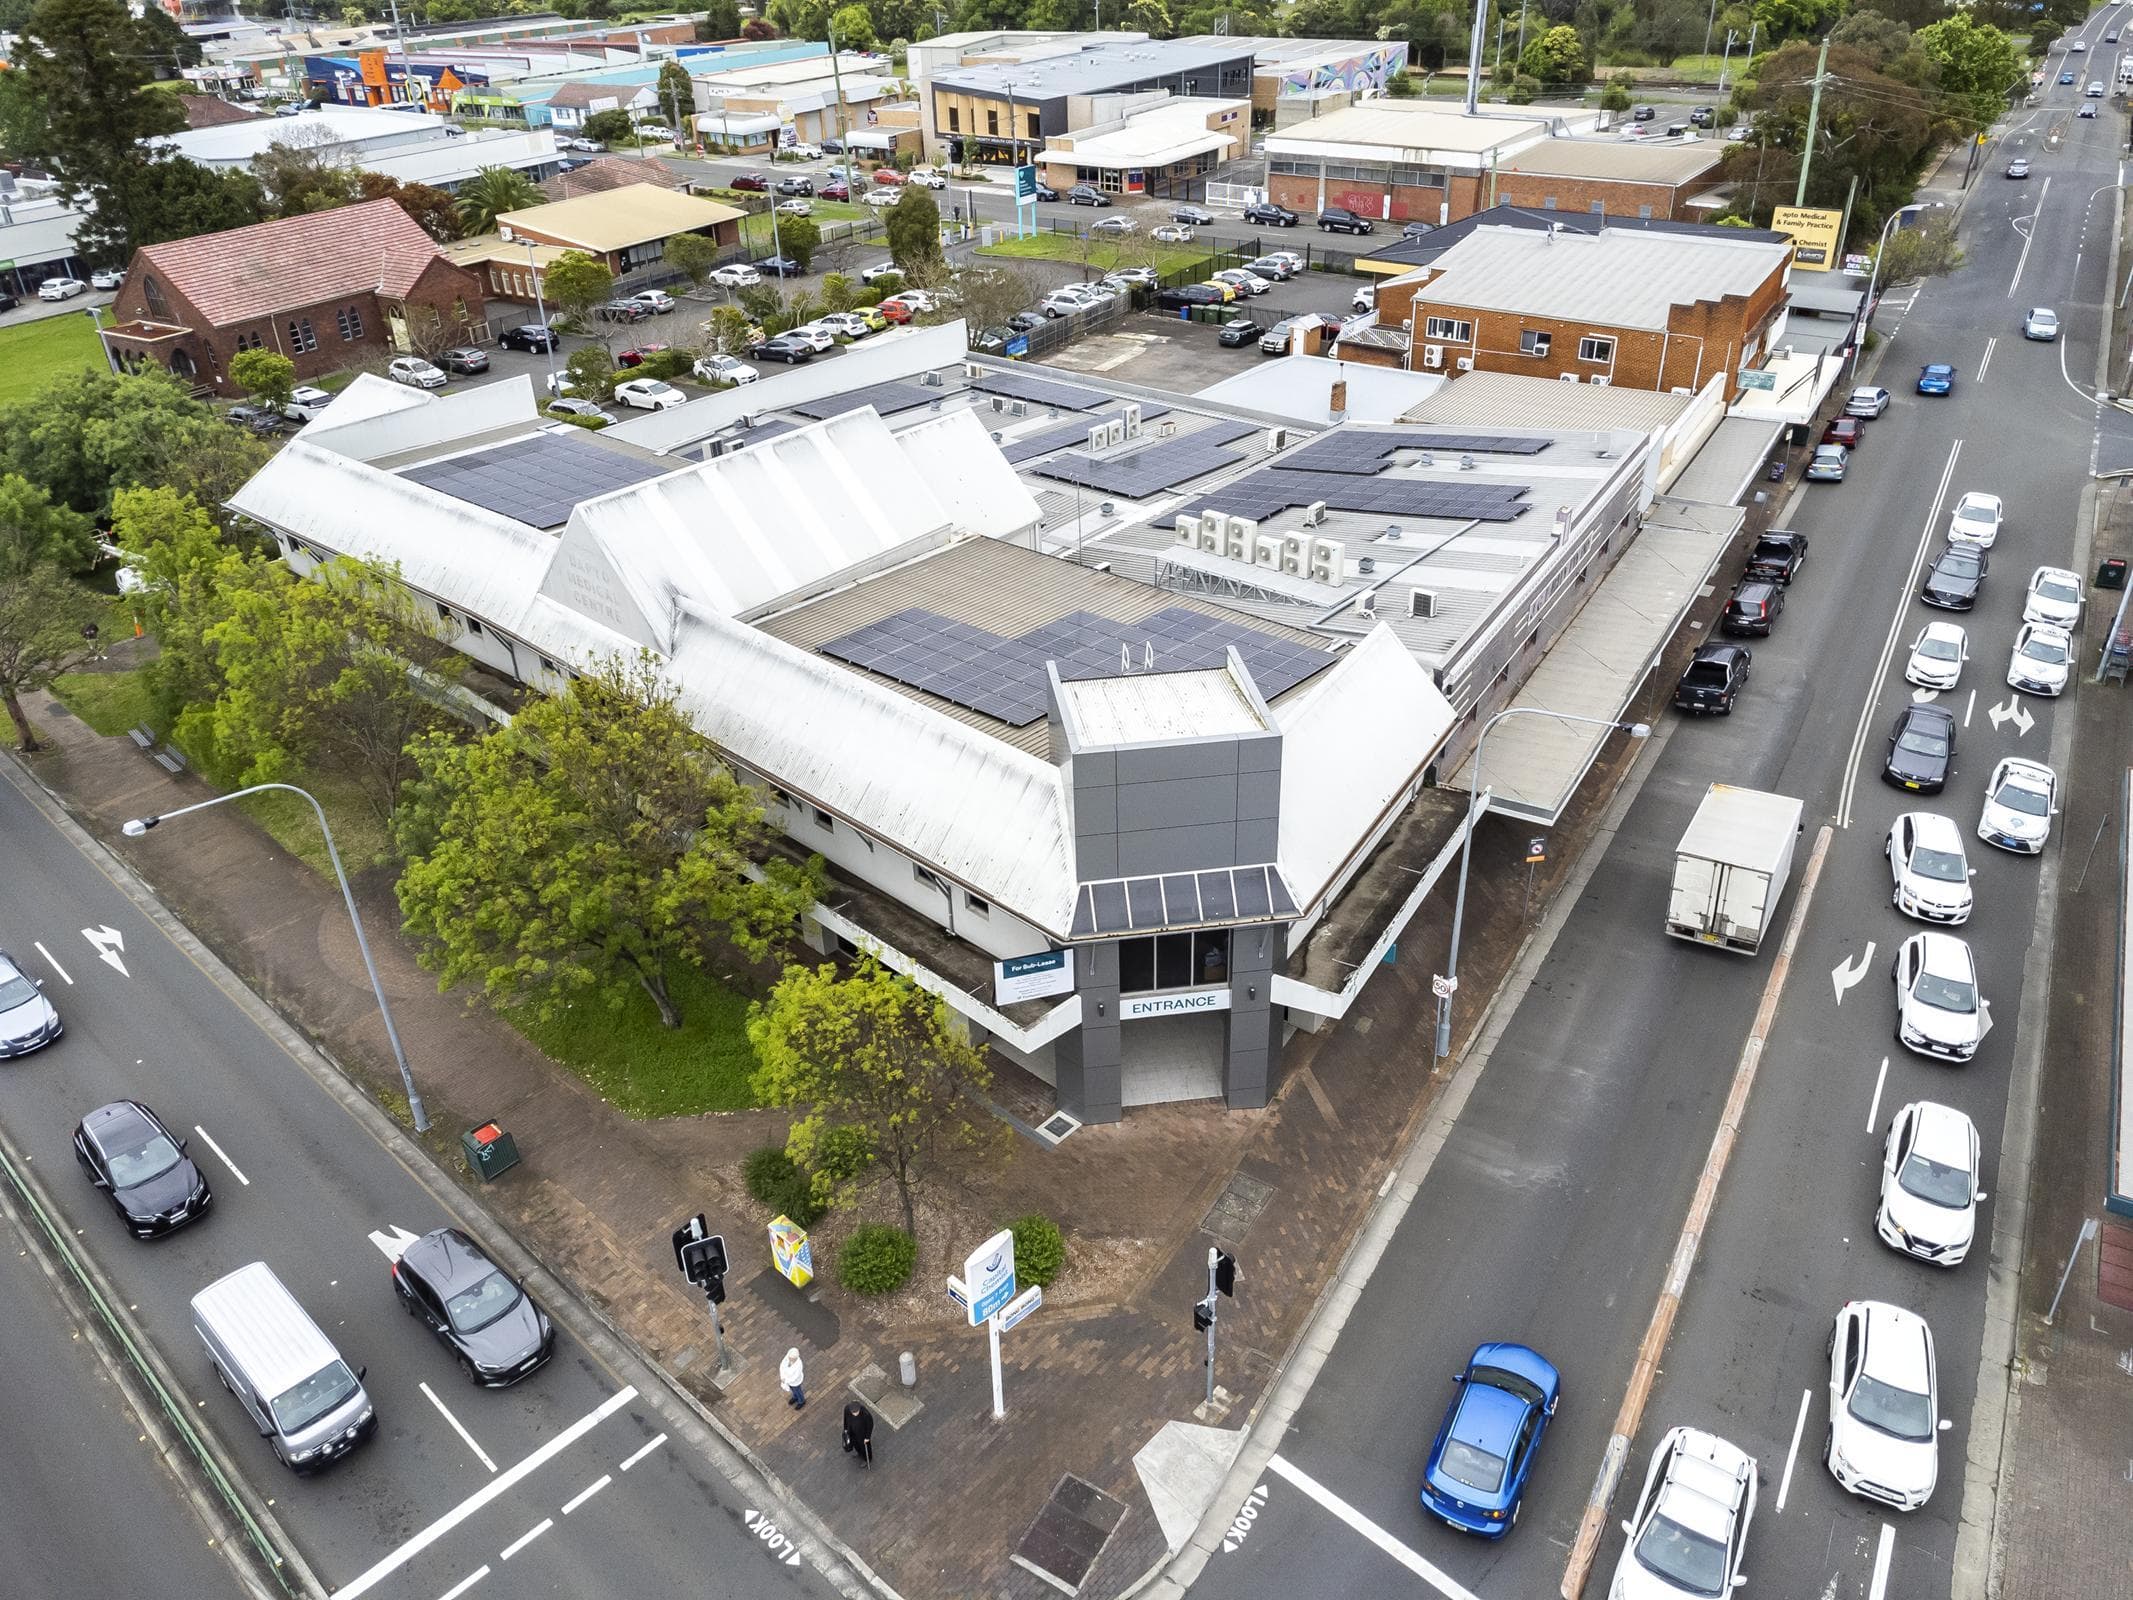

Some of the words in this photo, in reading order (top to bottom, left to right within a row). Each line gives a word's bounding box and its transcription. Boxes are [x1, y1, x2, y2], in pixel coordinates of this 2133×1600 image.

[1782, 212, 1799, 221] apto
[1800, 212, 1827, 220] Medical
[1783, 220, 1806, 229] Family
[1807, 221, 1834, 230] Practice
[1022, 959, 1057, 970] Sub-Lease
[1435, 981, 1447, 993] 50
[1132, 995, 1217, 1014] ENTRANCE
[981, 1269, 1009, 1294] Chemist
[982, 1264, 1007, 1287] Capital
[1226, 1495, 1266, 1544] LOOK
[747, 1515, 795, 1560] LOOK
